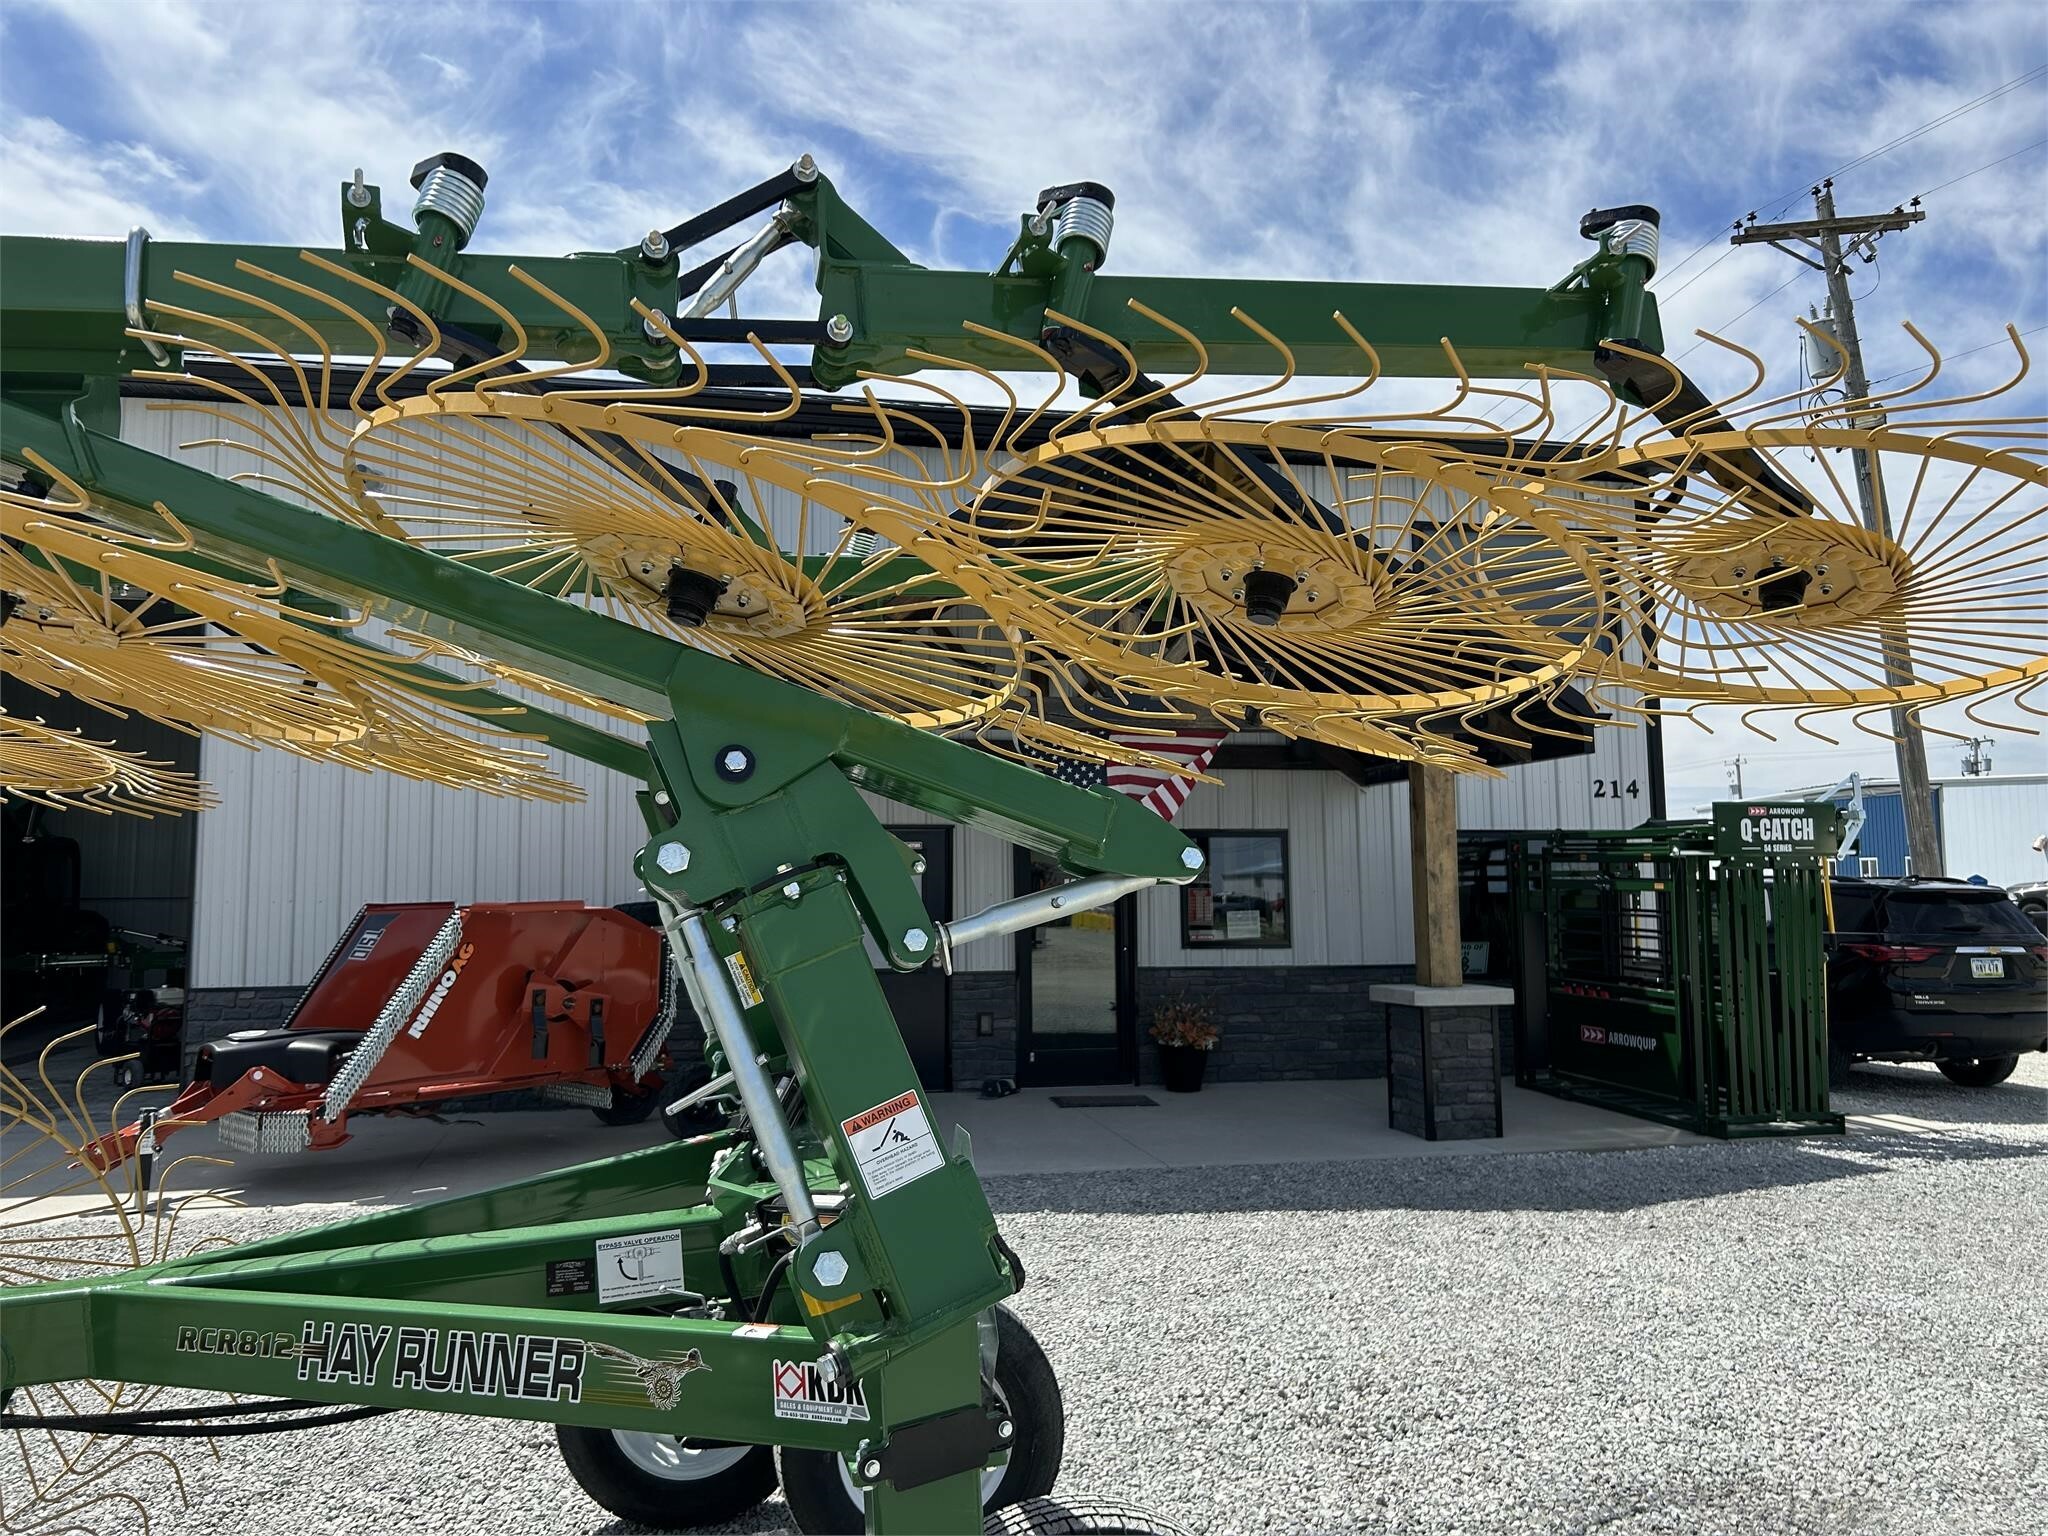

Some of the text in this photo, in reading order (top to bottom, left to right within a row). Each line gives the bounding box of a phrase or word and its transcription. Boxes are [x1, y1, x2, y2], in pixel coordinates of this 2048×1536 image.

[1593, 779, 1640, 799] 214
[1769, 807, 1805, 815] ARROWQUIP
[1740, 818, 1815, 843] Q-CATCH
[1773, 844, 1793, 852] SERIES
[742, 969, 756, 993] CAUTION
[1608, 1031, 1657, 1051] ARROWQUIP
[861, 1098, 911, 1126] WARNING
[876, 1142, 918, 1165] OVERHEAD HAZARD
[597, 1233, 680, 1250] BYPASS VALVE OPERATION
[176, 1320, 587, 1403] RCR812 HAY RUNNER
[780, 1401, 796, 1410] SALES
[802, 1403, 833, 1413] EQUIPMENT
